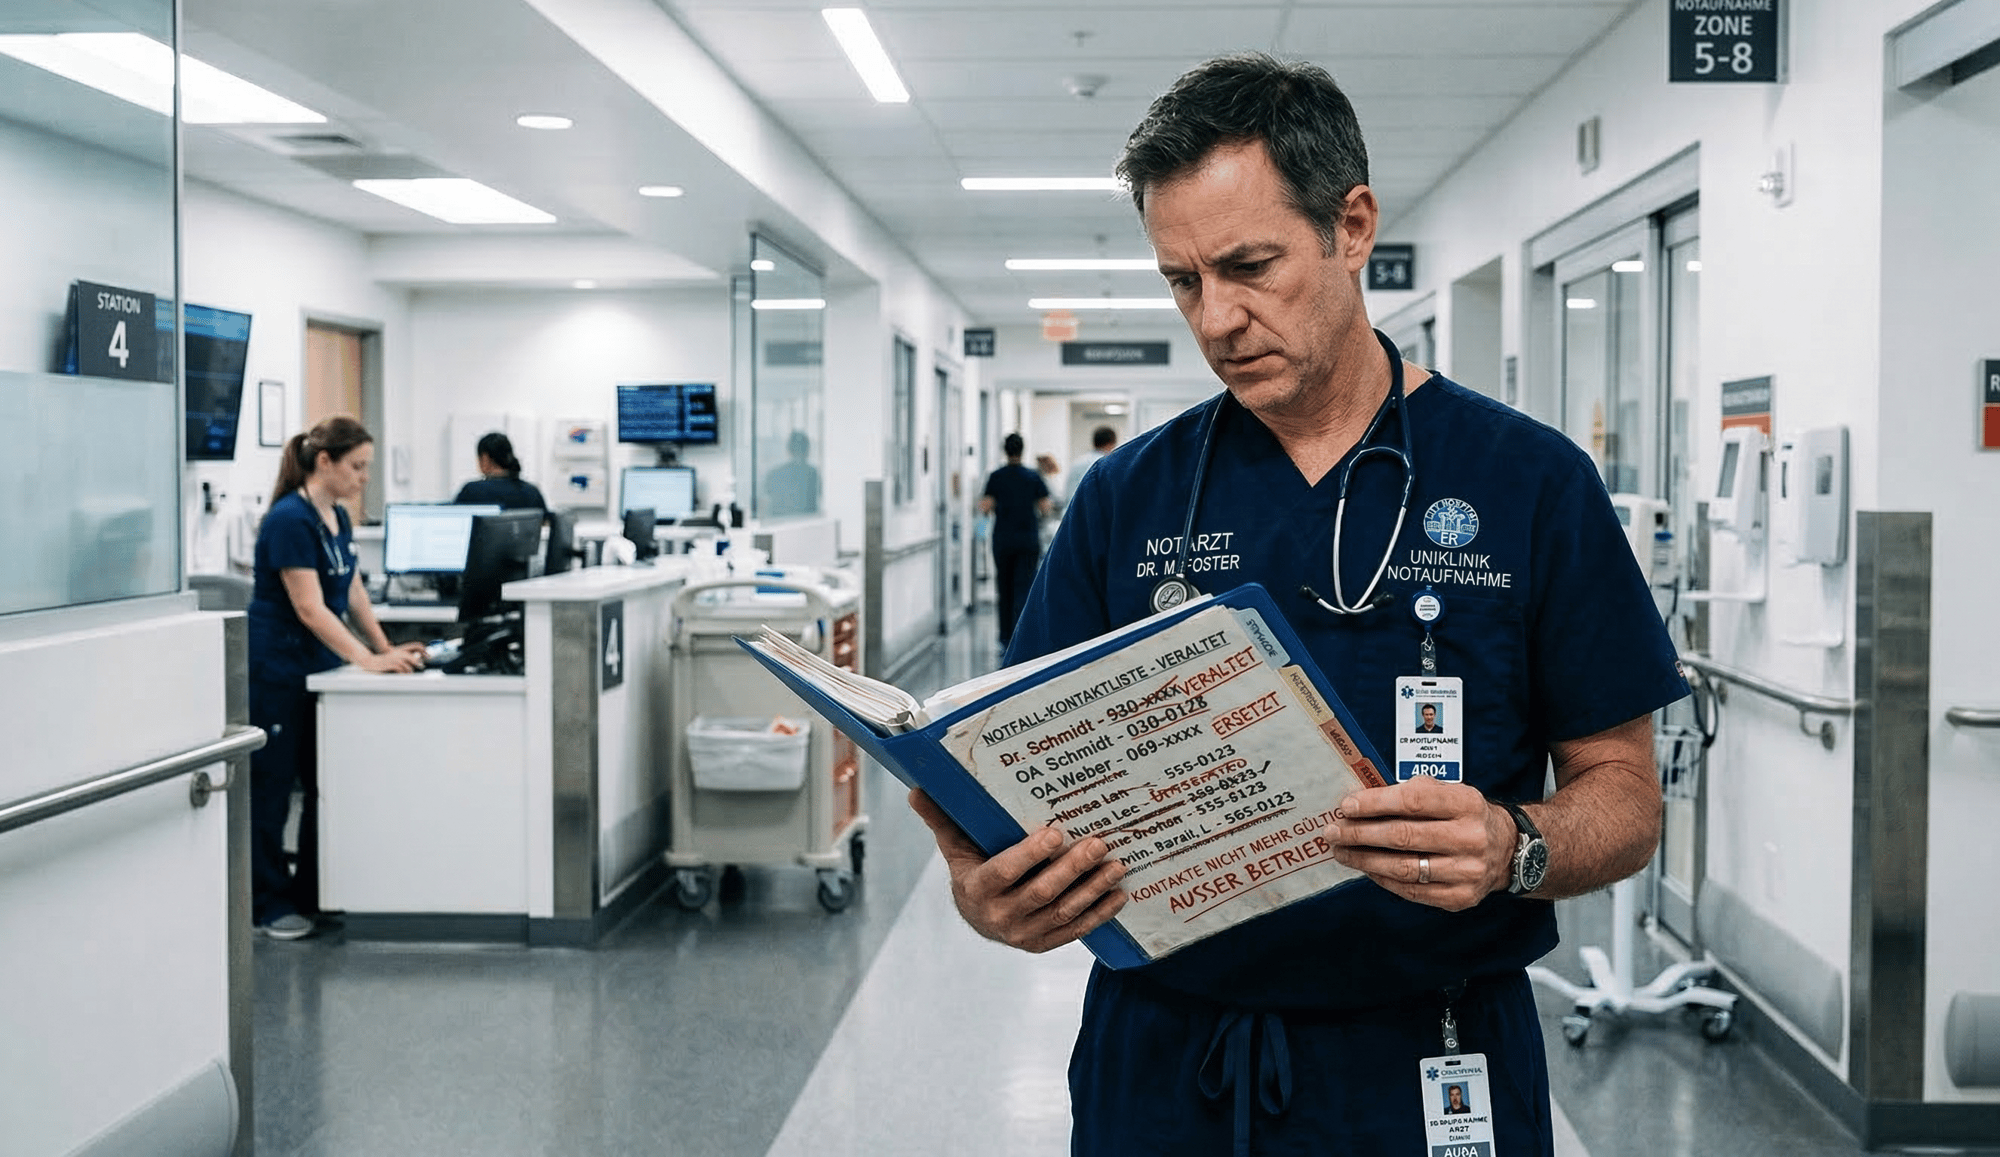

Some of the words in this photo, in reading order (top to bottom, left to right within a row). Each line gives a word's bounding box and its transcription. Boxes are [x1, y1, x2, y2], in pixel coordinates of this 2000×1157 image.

[1675, 0, 1772, 11] NOTAUFNAHME
[1694, 15, 1753, 35] ZONE
[1695, 42, 1753, 74] 5-8
[97, 291, 141, 315] STATION
[108, 320, 129, 369] 4
[1410, 550, 1490, 569] UNIKLINIK
[1441, 532, 1458, 545] ER
[1137, 562, 1158, 577] DR.
[1387, 565, 1511, 588] NOTAUFNAHME
[605, 618, 620, 676] 4
[982, 666, 1148, 745] NOTFALL-KONTAKTLISTE
[1155, 630, 1229, 670] VERALTET
[1177, 646, 1256, 697] VERALTET
[1211, 691, 1282, 736] ERSETZT
[999, 751, 1026, 767] Dr.
[1027, 718, 1096, 756] Schmidt
[1015, 765, 1045, 784] OA
[1045, 734, 1115, 771] Schmidt
[1057, 759, 1112, 790] Weber
[1126, 724, 1203, 761] 069-xxxx
[1131, 864, 1205, 902] KONTAKTE
[1205, 846, 1247, 872] NICHT
[1249, 829, 1293, 855] MEHR
[1293, 807, 1346, 836] GÜLTIG
[1169, 872, 1244, 914] AUSSER
[1244, 836, 1331, 882] BETRIEB
